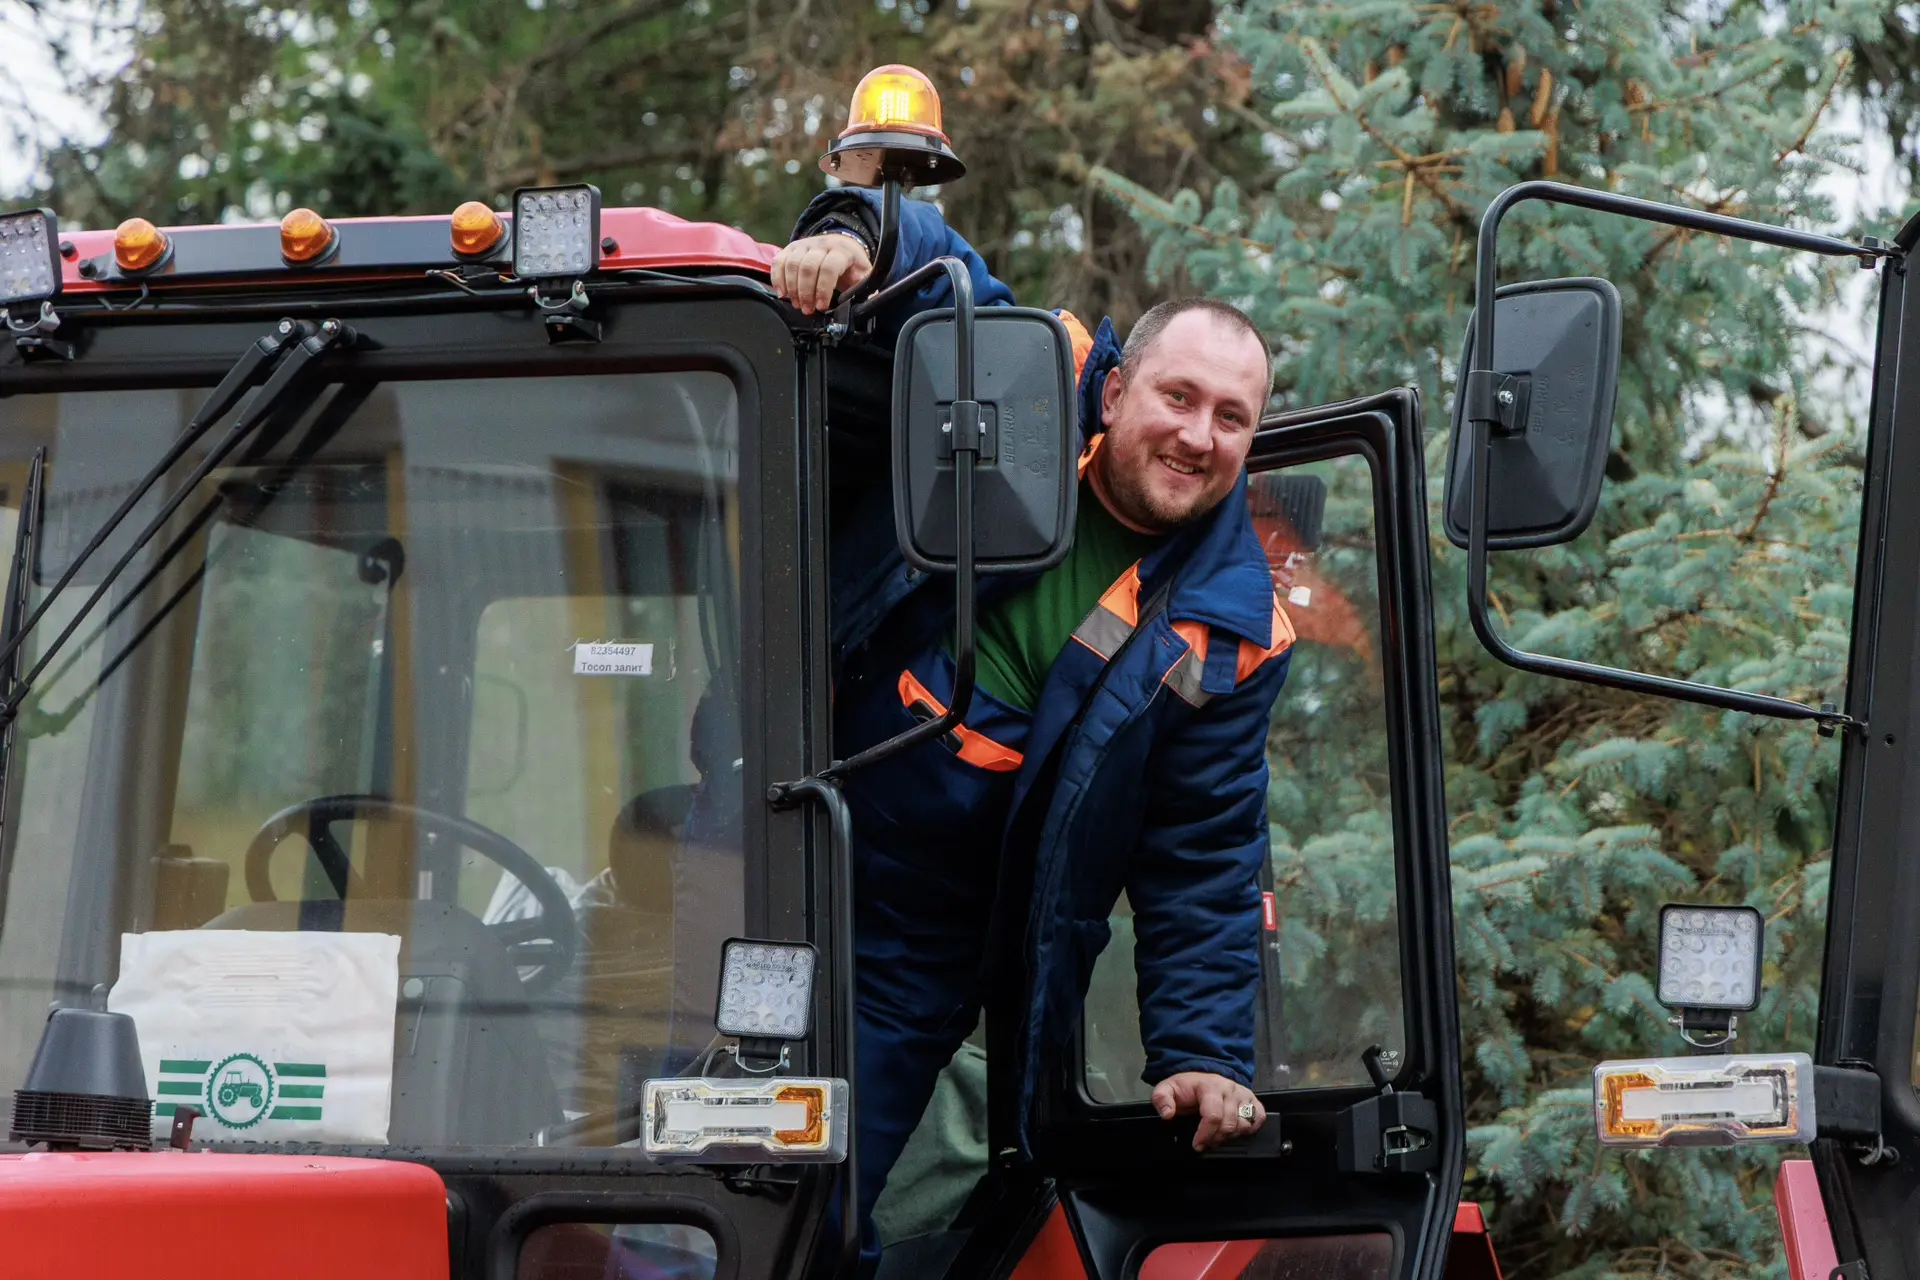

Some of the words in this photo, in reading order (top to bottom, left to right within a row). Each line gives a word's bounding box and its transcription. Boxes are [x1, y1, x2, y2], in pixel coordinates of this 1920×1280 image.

[1004, 406, 1016, 465] BELARUS
[581, 662, 612, 672] Тосол
[614, 663, 643, 673] залит
